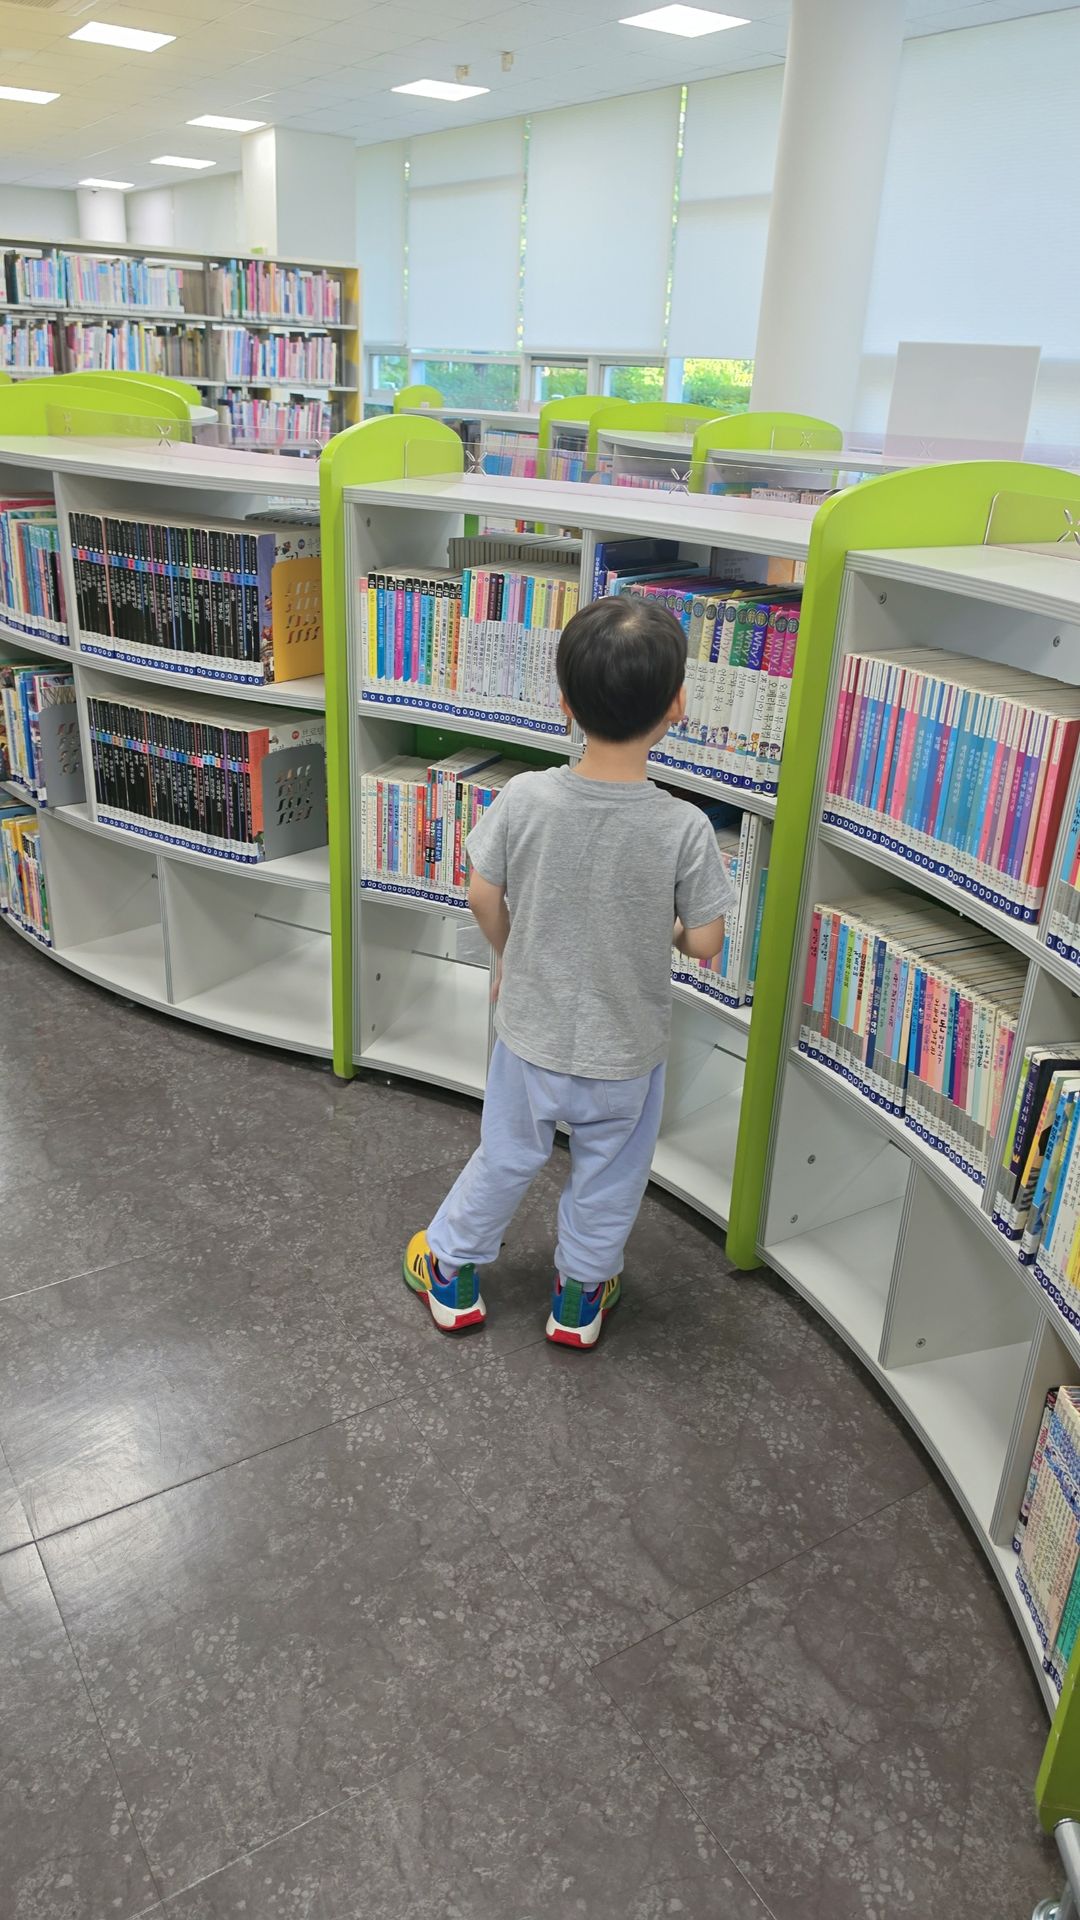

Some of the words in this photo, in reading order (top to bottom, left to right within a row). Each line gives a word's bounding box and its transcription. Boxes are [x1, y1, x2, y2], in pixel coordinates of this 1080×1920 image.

[740, 628, 753, 664] Why?
[749, 630, 763, 666] Why?
[769, 637, 784, 672] Why?
[781, 637, 794, 674] Why?
